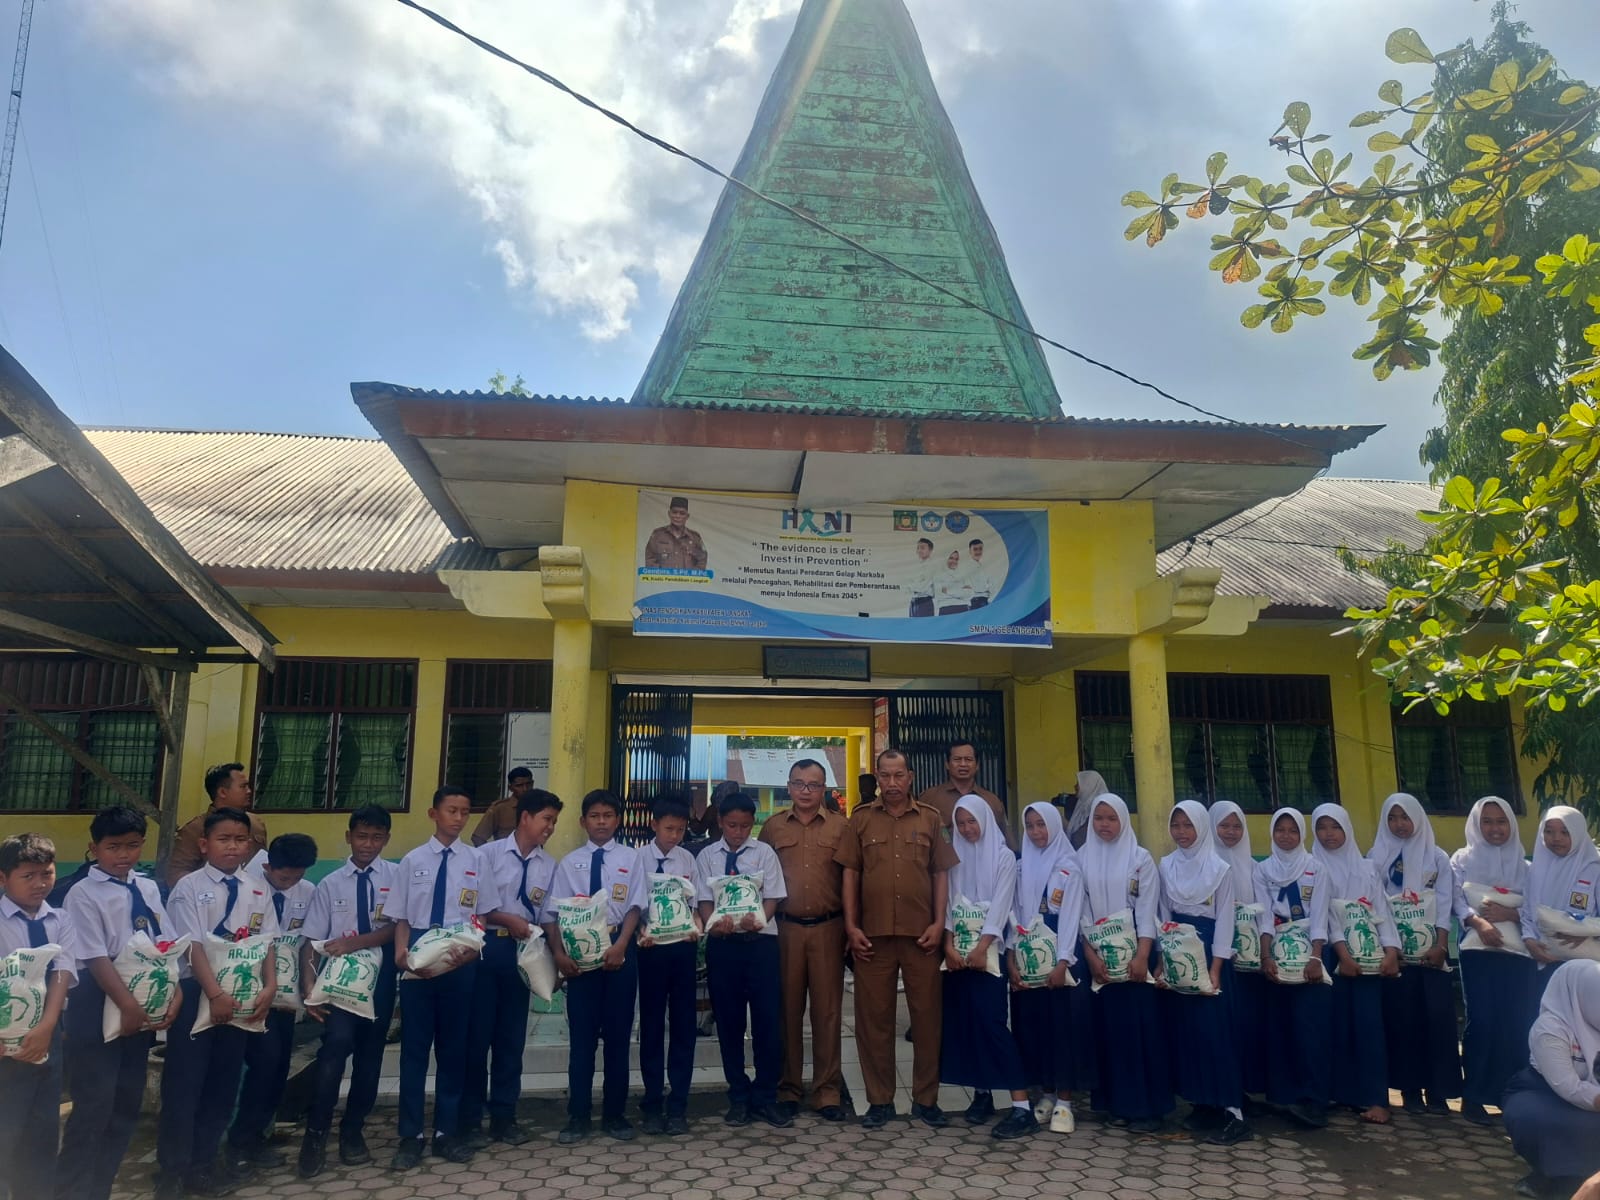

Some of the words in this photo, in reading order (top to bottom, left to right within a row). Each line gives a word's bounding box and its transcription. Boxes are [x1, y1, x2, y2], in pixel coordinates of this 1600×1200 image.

[760, 542, 779, 551] The
[781, 543, 827, 554] evidence
[829, 545, 838, 555] is
[761, 554, 791, 564] Invest
[794, 555, 804, 564] in
[807, 556, 861, 567] Prevention
[776, 568, 798, 576] Rantai
[857, 571, 885, 579] Narkoba
[722, 577, 747, 585] melalui
[794, 580, 834, 588] Rehabilitasi
[849, 581, 900, 590] Pemberantasan
[760, 590, 786, 598] menuju
[787, 590, 820, 598] Indonesia
[841, 592, 858, 600] 2045
